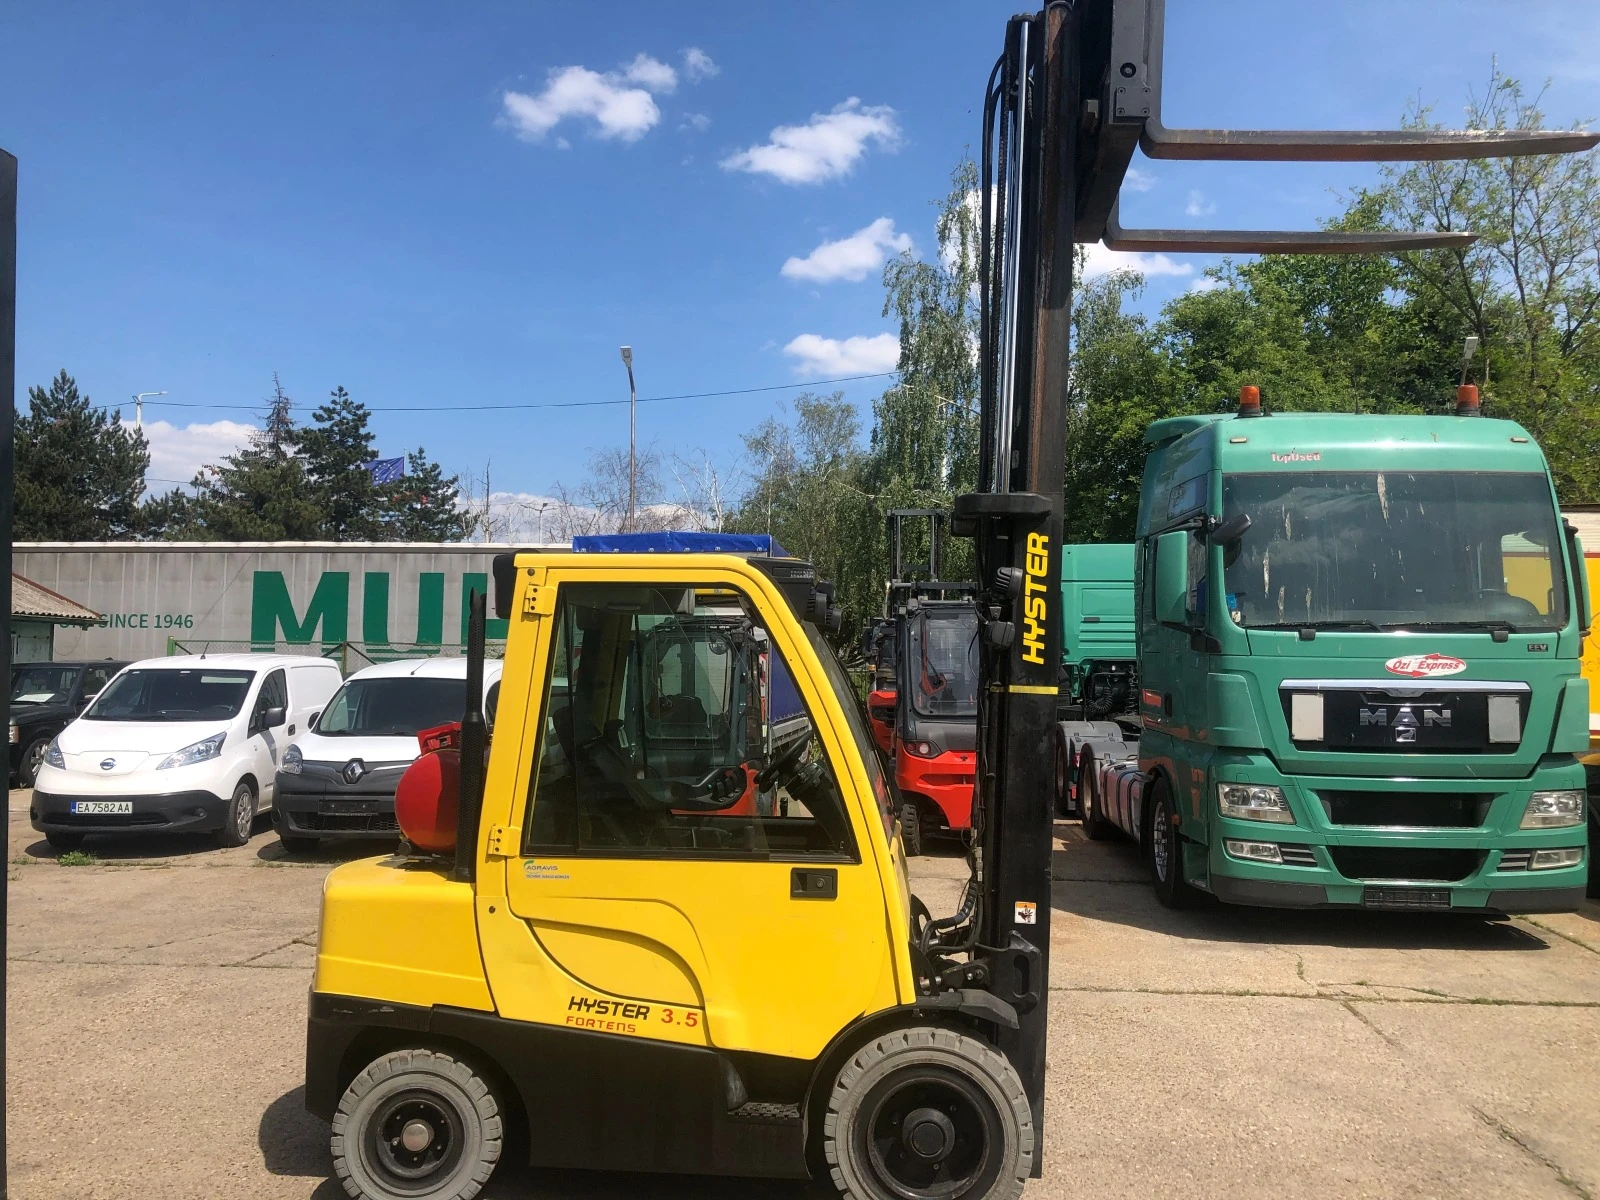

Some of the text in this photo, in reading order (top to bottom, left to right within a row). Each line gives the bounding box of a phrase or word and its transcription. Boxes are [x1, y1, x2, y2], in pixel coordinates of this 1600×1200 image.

[1022, 532, 1049, 665] HYSTER
[98, 613, 194, 629] SINCE 1946
[1417, 660, 1460, 671] Express
[1359, 707, 1452, 727] MAN
[77, 803, 90, 812] EA
[91, 803, 116, 812] 7582
[117, 803, 130, 812] AA
[568, 996, 698, 1027] HYSTER 3.5
[566, 1016, 636, 1033] FORTENS
